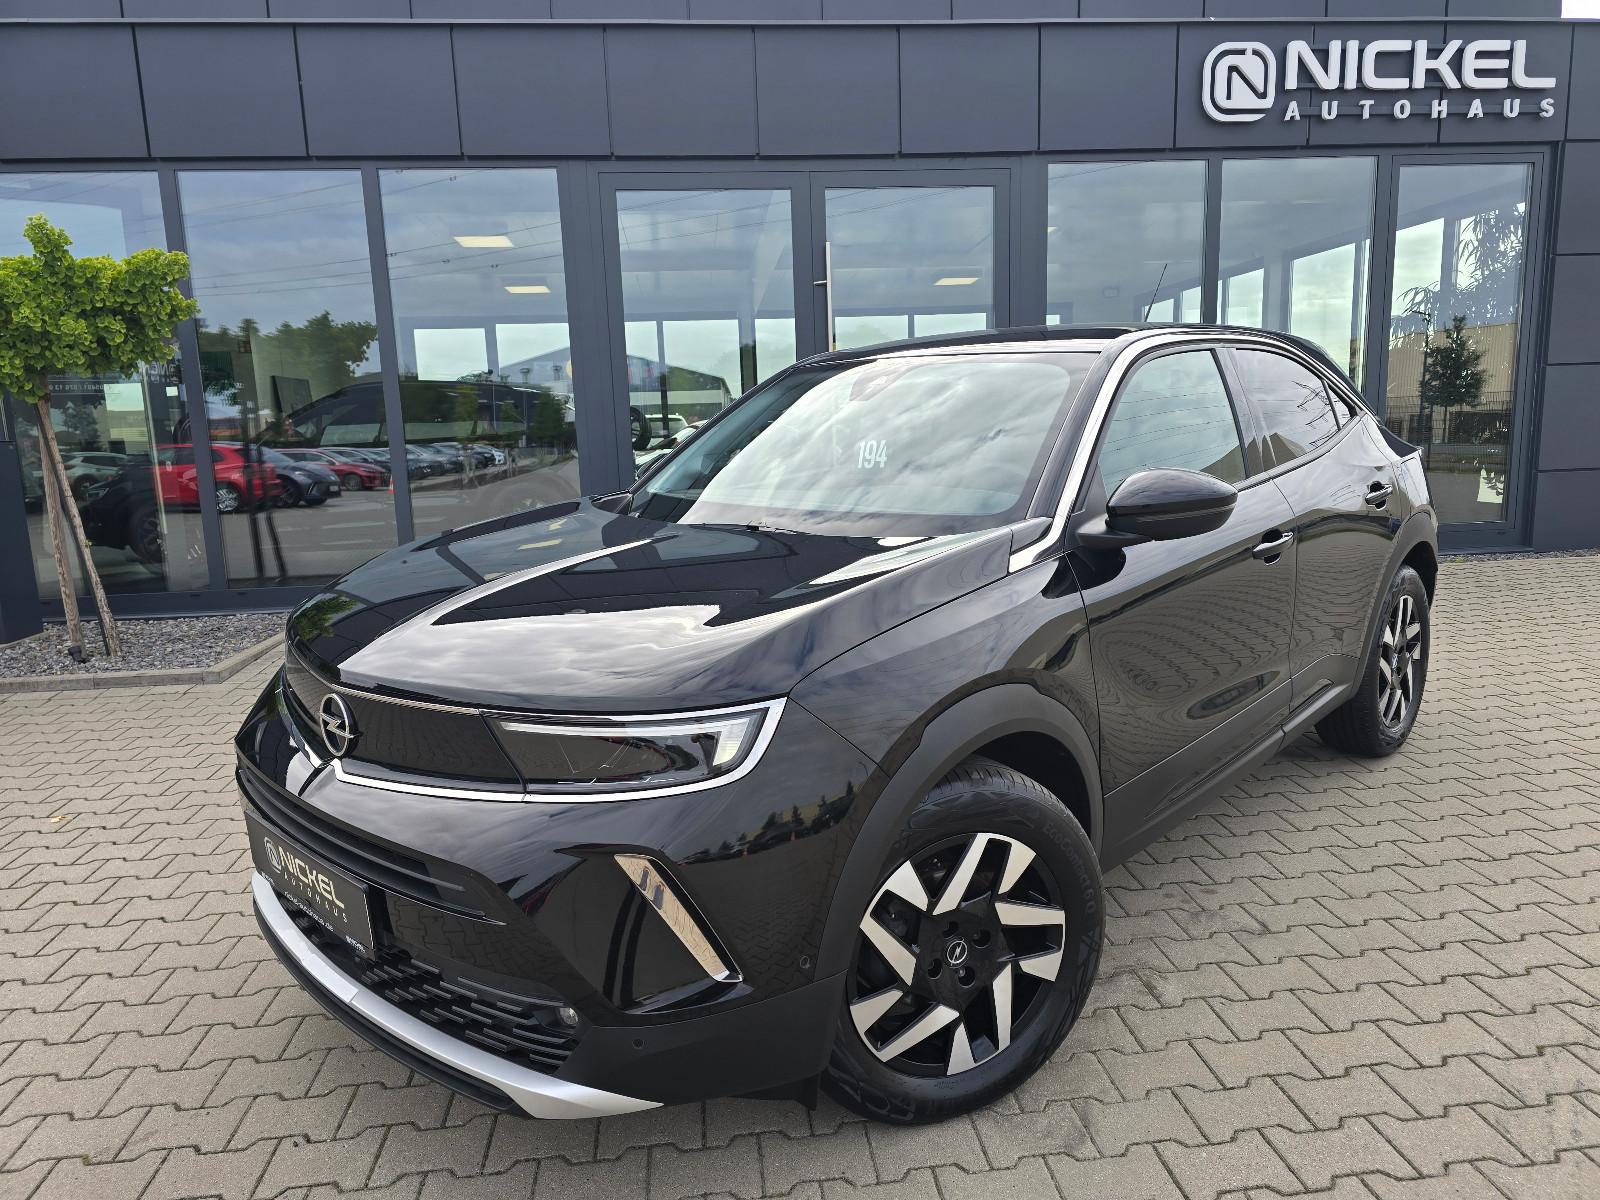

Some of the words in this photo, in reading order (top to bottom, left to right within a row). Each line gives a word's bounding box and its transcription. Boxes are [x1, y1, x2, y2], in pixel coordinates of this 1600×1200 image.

[1284, 39, 1557, 91] NICKEL
[1283, 97, 1556, 121] AUTOHAUS
[857, 439, 888, 469] 194
[278, 846, 345, 909] NICKEL
[283, 872, 348, 923] AUTOHAUS
